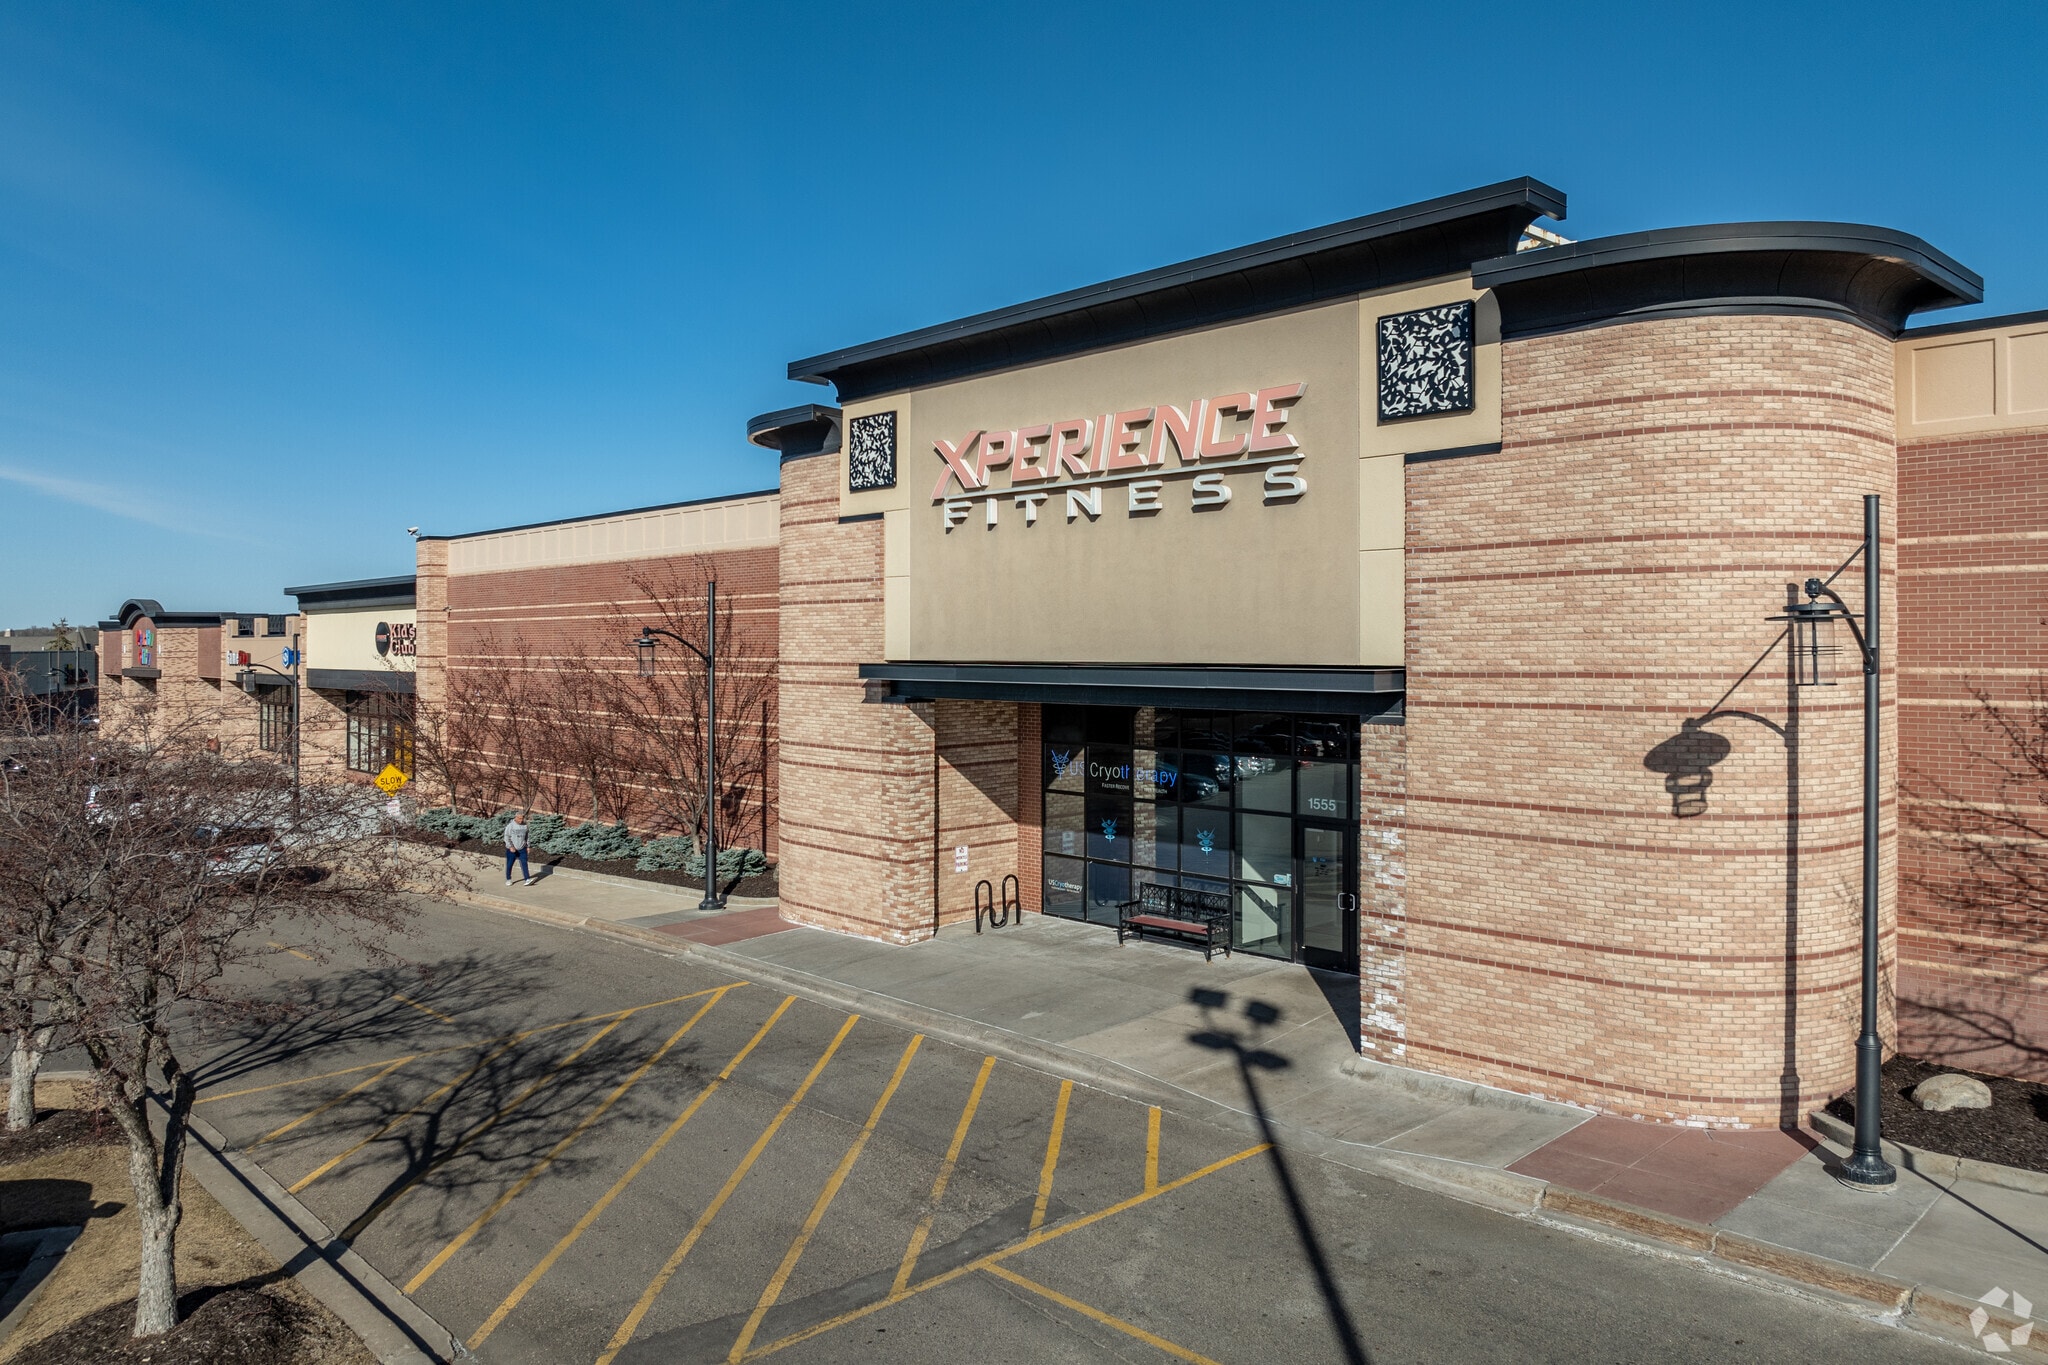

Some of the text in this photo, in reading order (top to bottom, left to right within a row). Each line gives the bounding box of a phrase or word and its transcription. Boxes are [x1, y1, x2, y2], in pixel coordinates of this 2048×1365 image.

[931, 382, 1308, 501] XPERIENCE
[944, 464, 1308, 530] FITNESS
[389, 623, 416, 639] Kid's
[389, 640, 416, 655] Club
[380, 776, 402, 786] SLOW
[1308, 797, 1337, 812] 1555
